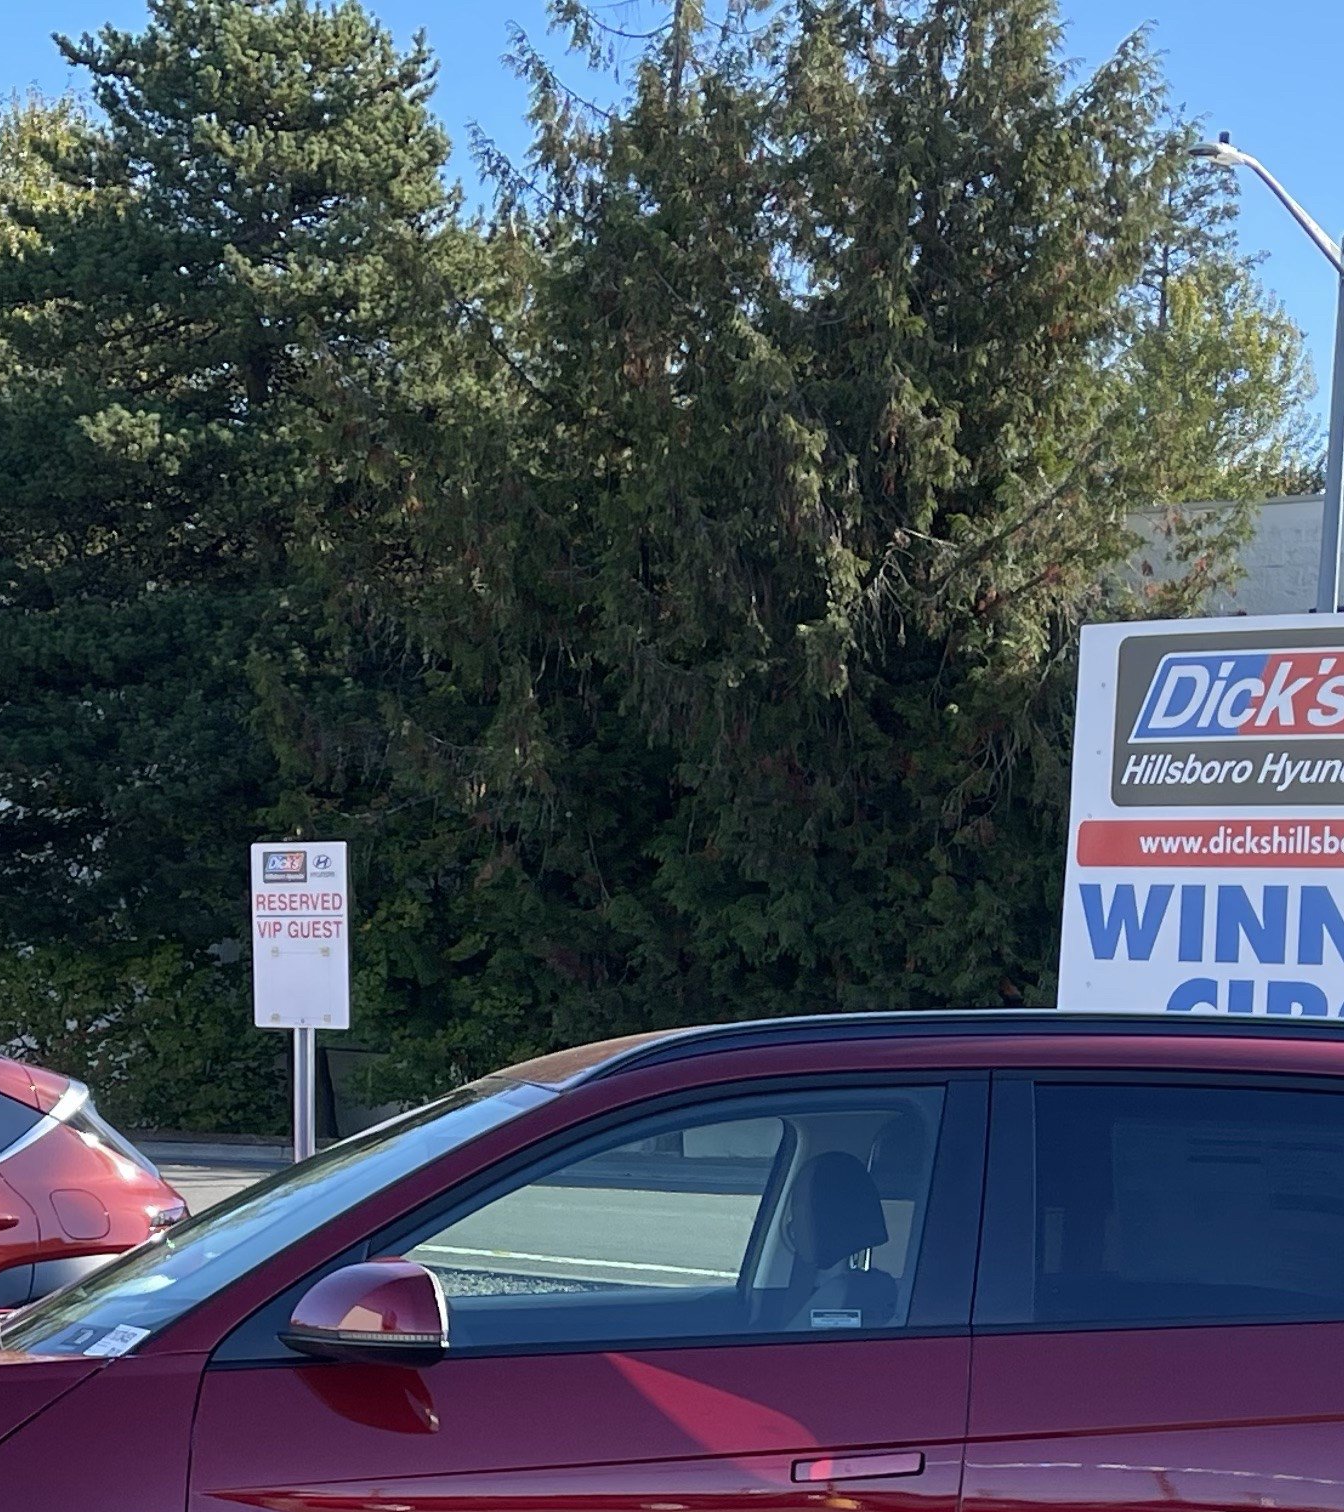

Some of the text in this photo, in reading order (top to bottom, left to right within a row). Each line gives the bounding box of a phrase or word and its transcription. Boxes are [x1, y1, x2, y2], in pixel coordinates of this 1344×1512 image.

[1120, 752, 1254, 786] Hillsboro
[256, 892, 343, 911] RESERVED
[257, 920, 343, 939] VIP GUEST
